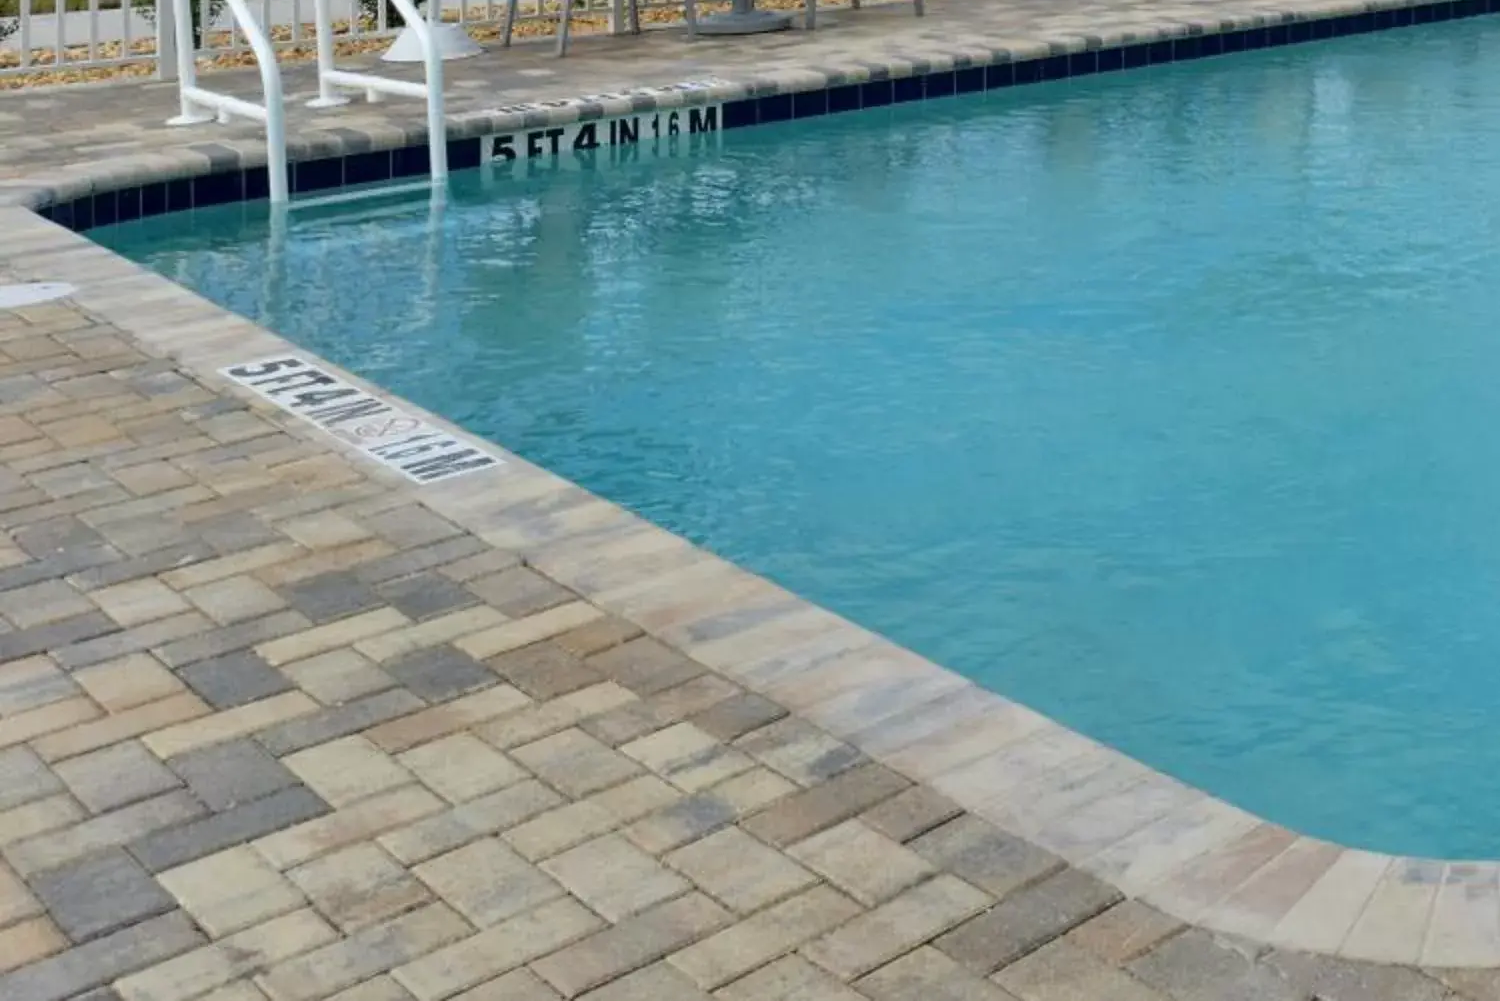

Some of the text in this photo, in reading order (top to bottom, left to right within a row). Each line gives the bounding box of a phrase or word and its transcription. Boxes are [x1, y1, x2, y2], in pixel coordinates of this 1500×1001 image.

[491, 135, 516, 160] 5
[527, 128, 564, 158] FT
[573, 122, 600, 150] 4
[610, 117, 639, 146] IN
[689, 106, 717, 134] M
